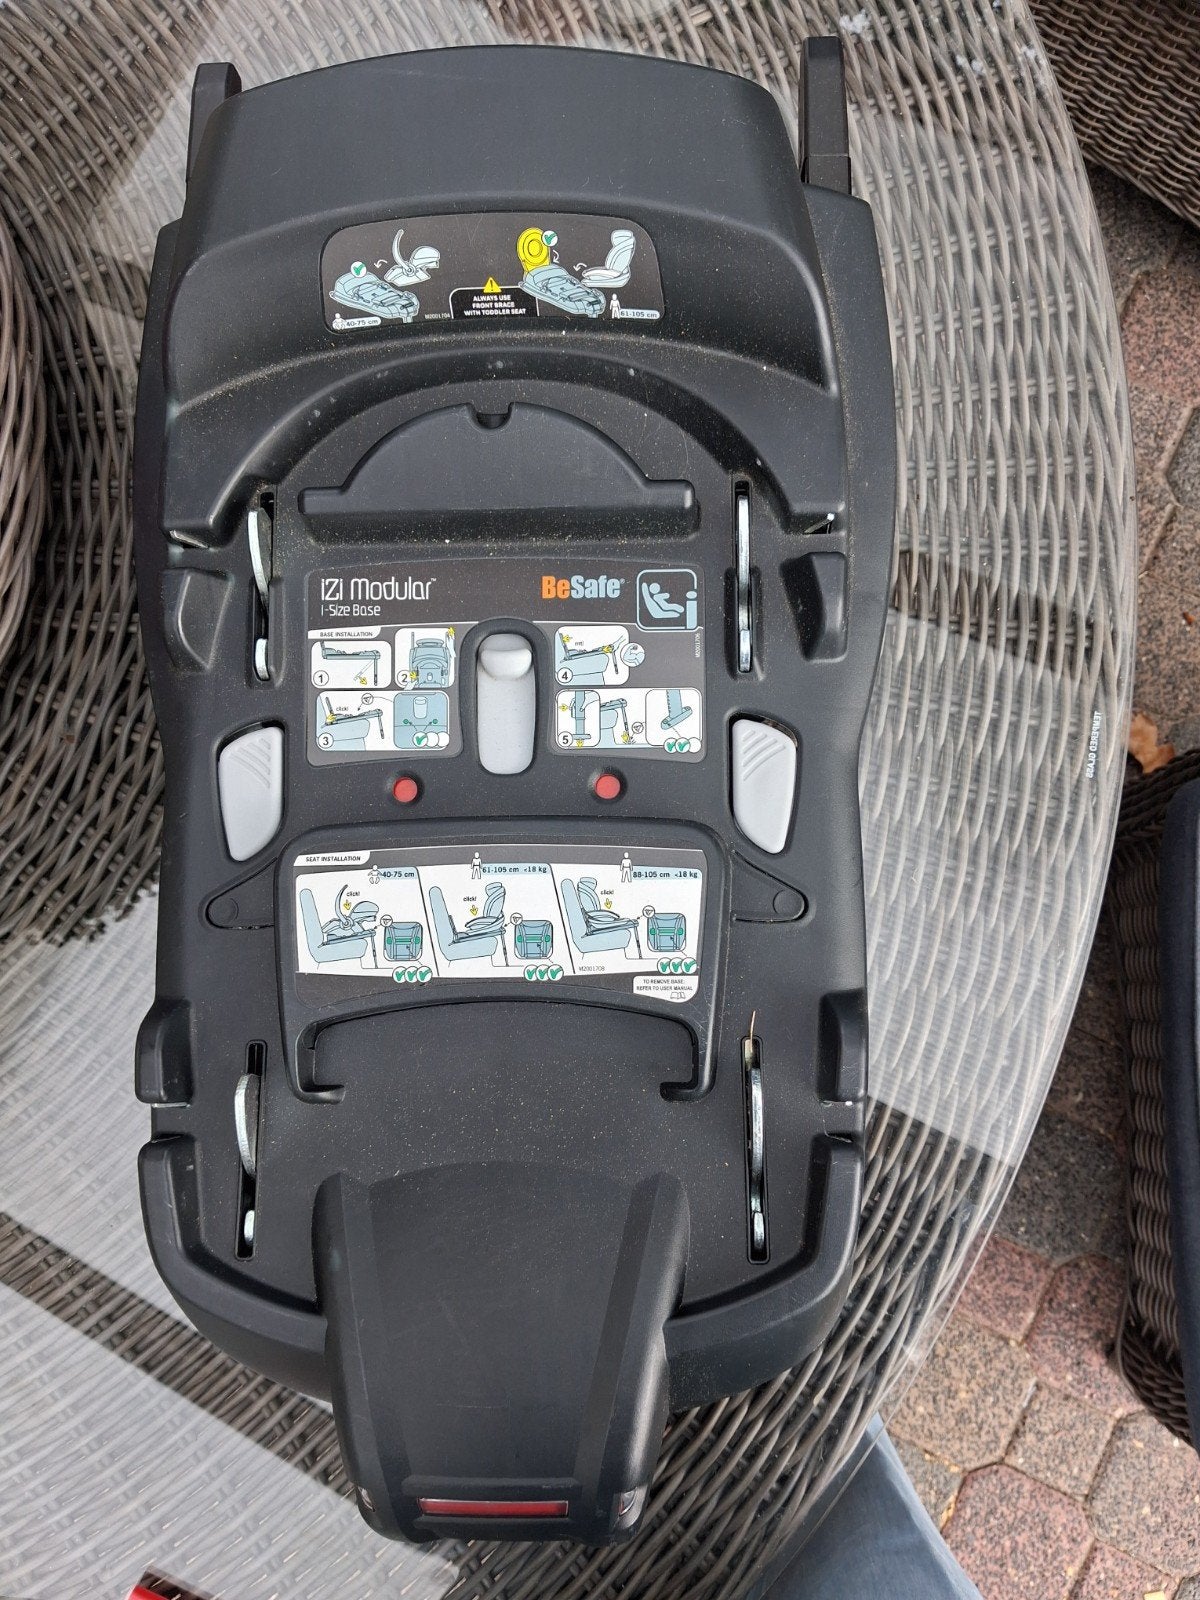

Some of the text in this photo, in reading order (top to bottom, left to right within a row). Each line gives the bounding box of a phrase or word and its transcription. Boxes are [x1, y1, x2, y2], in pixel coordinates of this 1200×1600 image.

[321, 604, 380, 616] i-Size Base
[401, 673, 408, 683] 2
[561, 671, 568, 680] 4
[322, 736, 329, 746] 3
[562, 735, 569, 745] 5
[538, 866, 547, 874] kg
